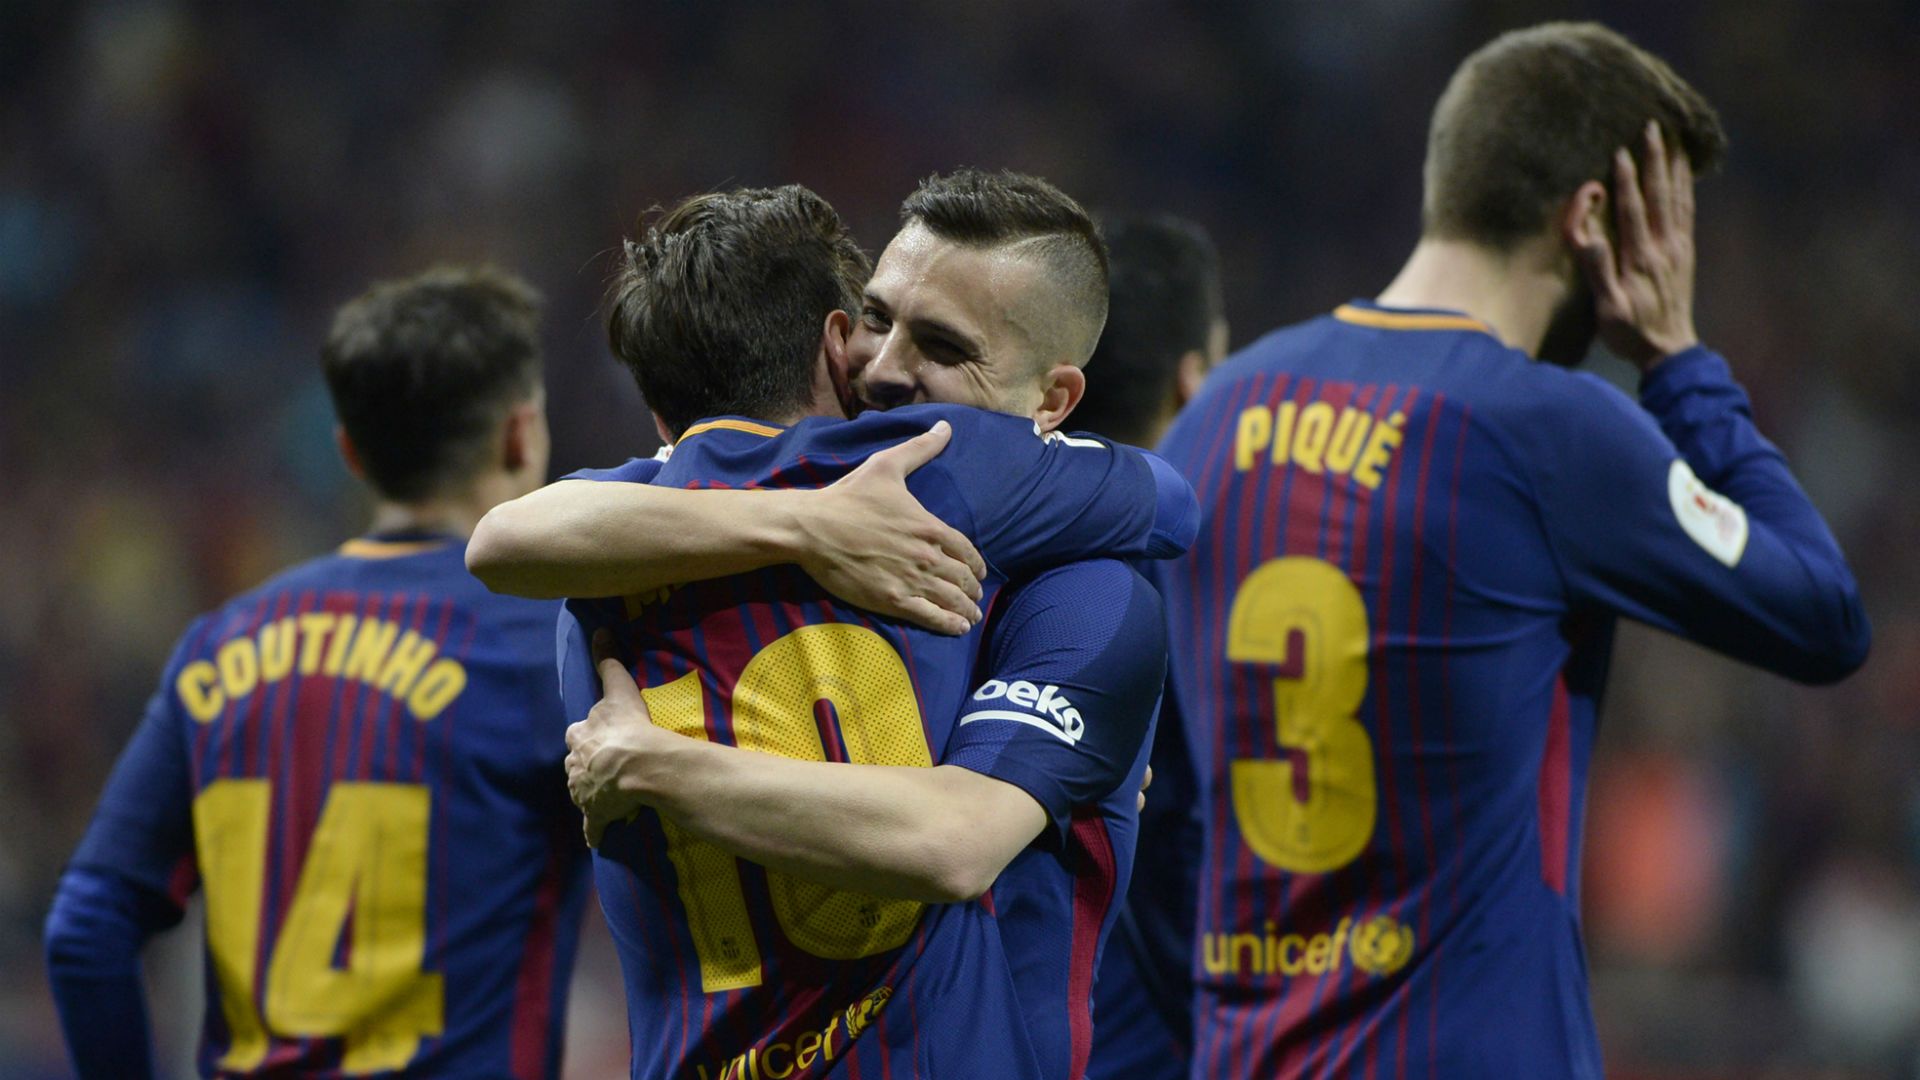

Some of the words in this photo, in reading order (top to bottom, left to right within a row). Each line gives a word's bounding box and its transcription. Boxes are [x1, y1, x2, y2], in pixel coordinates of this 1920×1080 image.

[1235, 400, 1406, 490] PIQUÉ
[177, 613, 467, 722] COUTINHO
[1227, 555, 1376, 874] 3
[641, 623, 934, 993] 10
[193, 778, 444, 1074] 14
[1203, 916, 1351, 976] unicef
